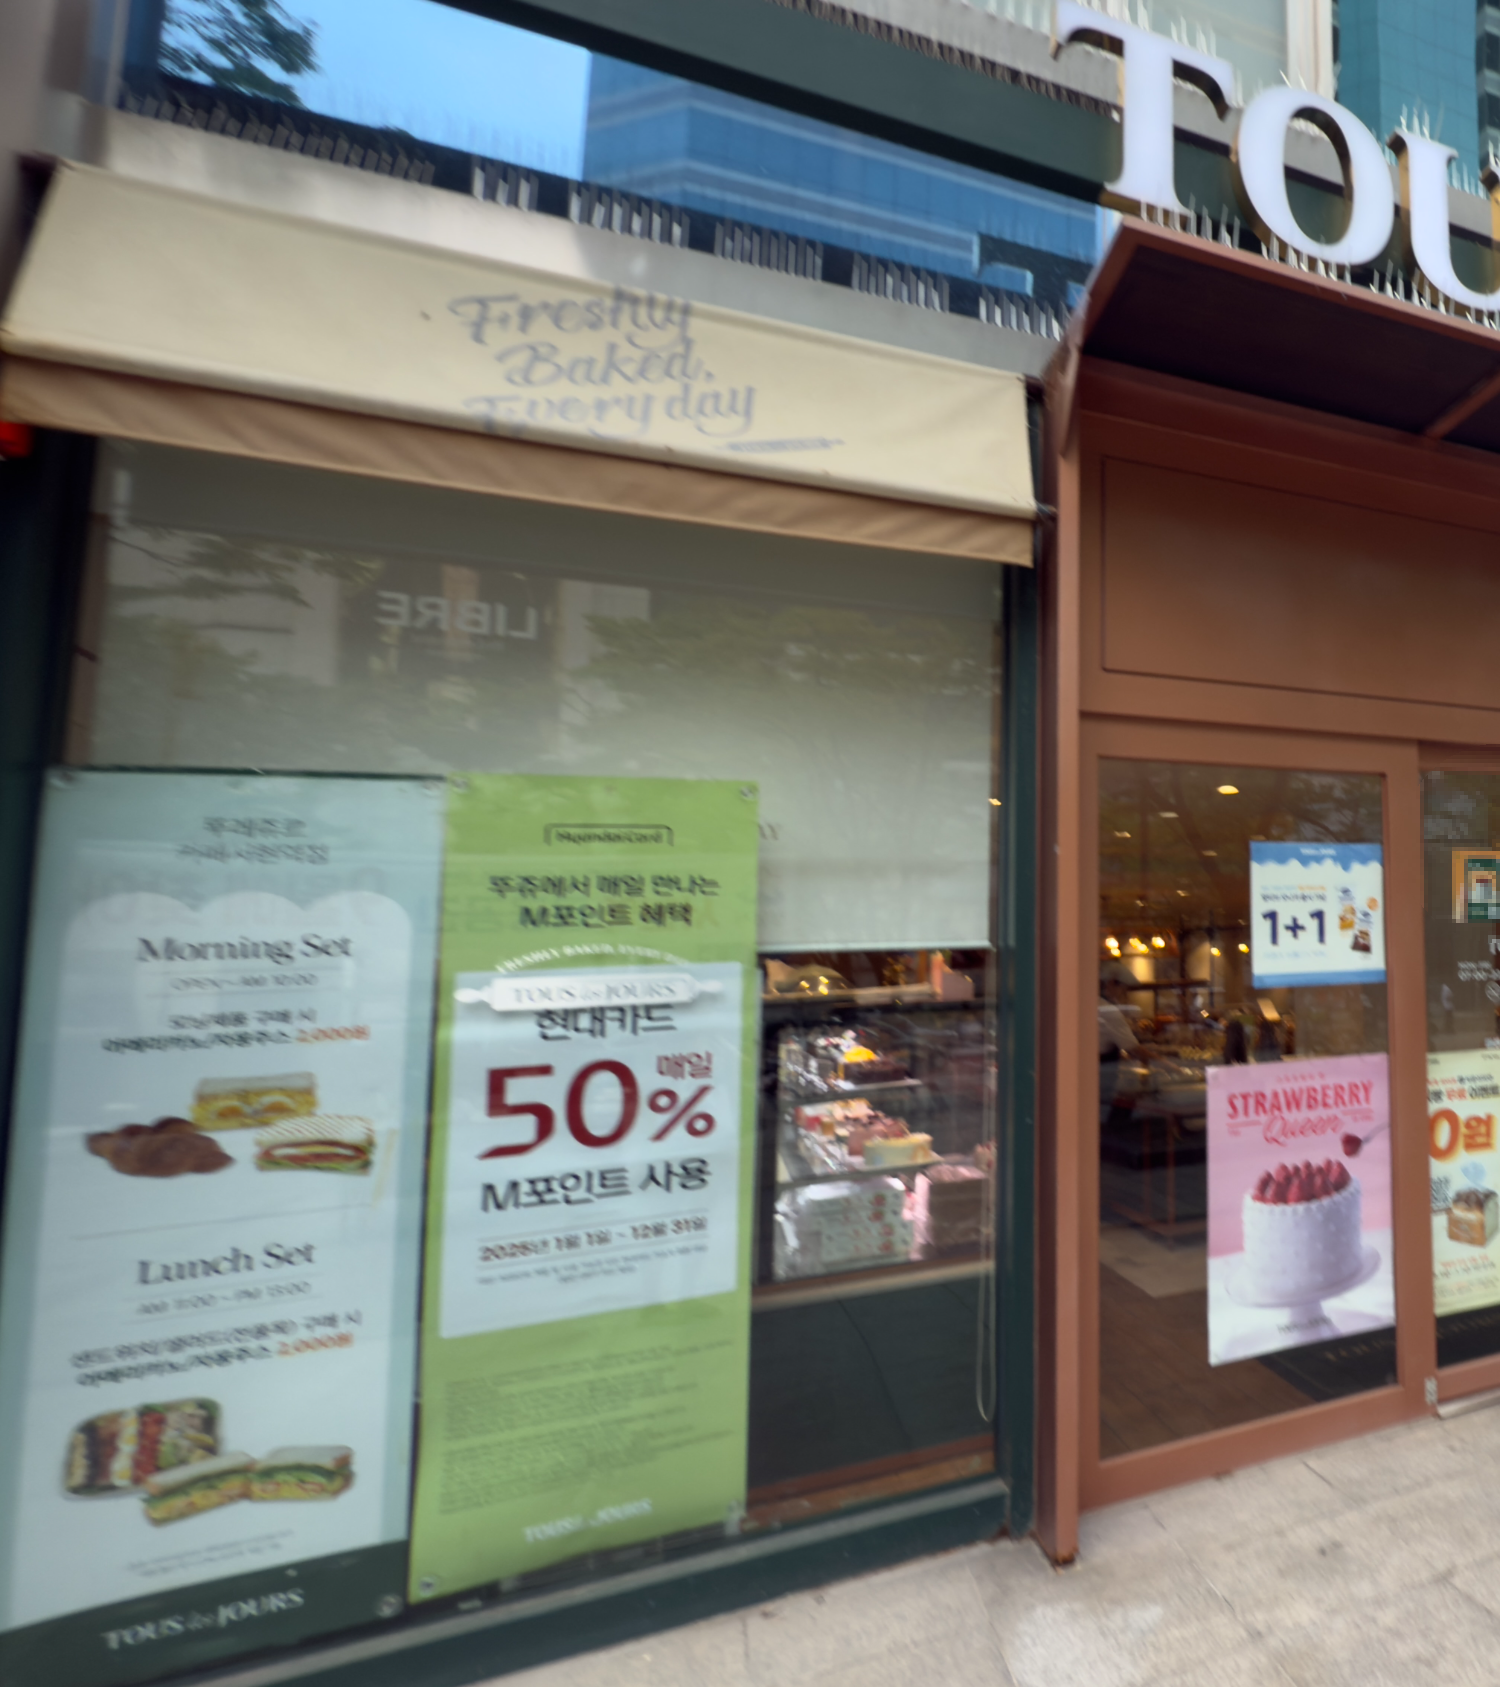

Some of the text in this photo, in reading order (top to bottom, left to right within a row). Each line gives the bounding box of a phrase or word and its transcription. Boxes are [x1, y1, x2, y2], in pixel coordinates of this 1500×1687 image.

[446, 287, 695, 350] Freshly
[597, 873, 645, 898] 매일
[652, 873, 721, 897] 만나는
[519, 901, 694, 928] M포인트 혜택
[1260, 908, 1328, 946] 1+1
[135, 932, 353, 967] Morning Set
[534, 1003, 678, 1041] 현대카드
[656, 1051, 713, 1080] 매일
[474, 1057, 718, 1161] 50%
[1226, 1079, 1375, 1121] STRAWBERRY
[1262, 1112, 1346, 1148] Queen
[479, 1156, 713, 1214] M포인트 사용
[137, 1240, 318, 1287] Lunch Set
[101, 1612, 185, 1651] TOUS
[216, 1586, 305, 1630] JOURS
